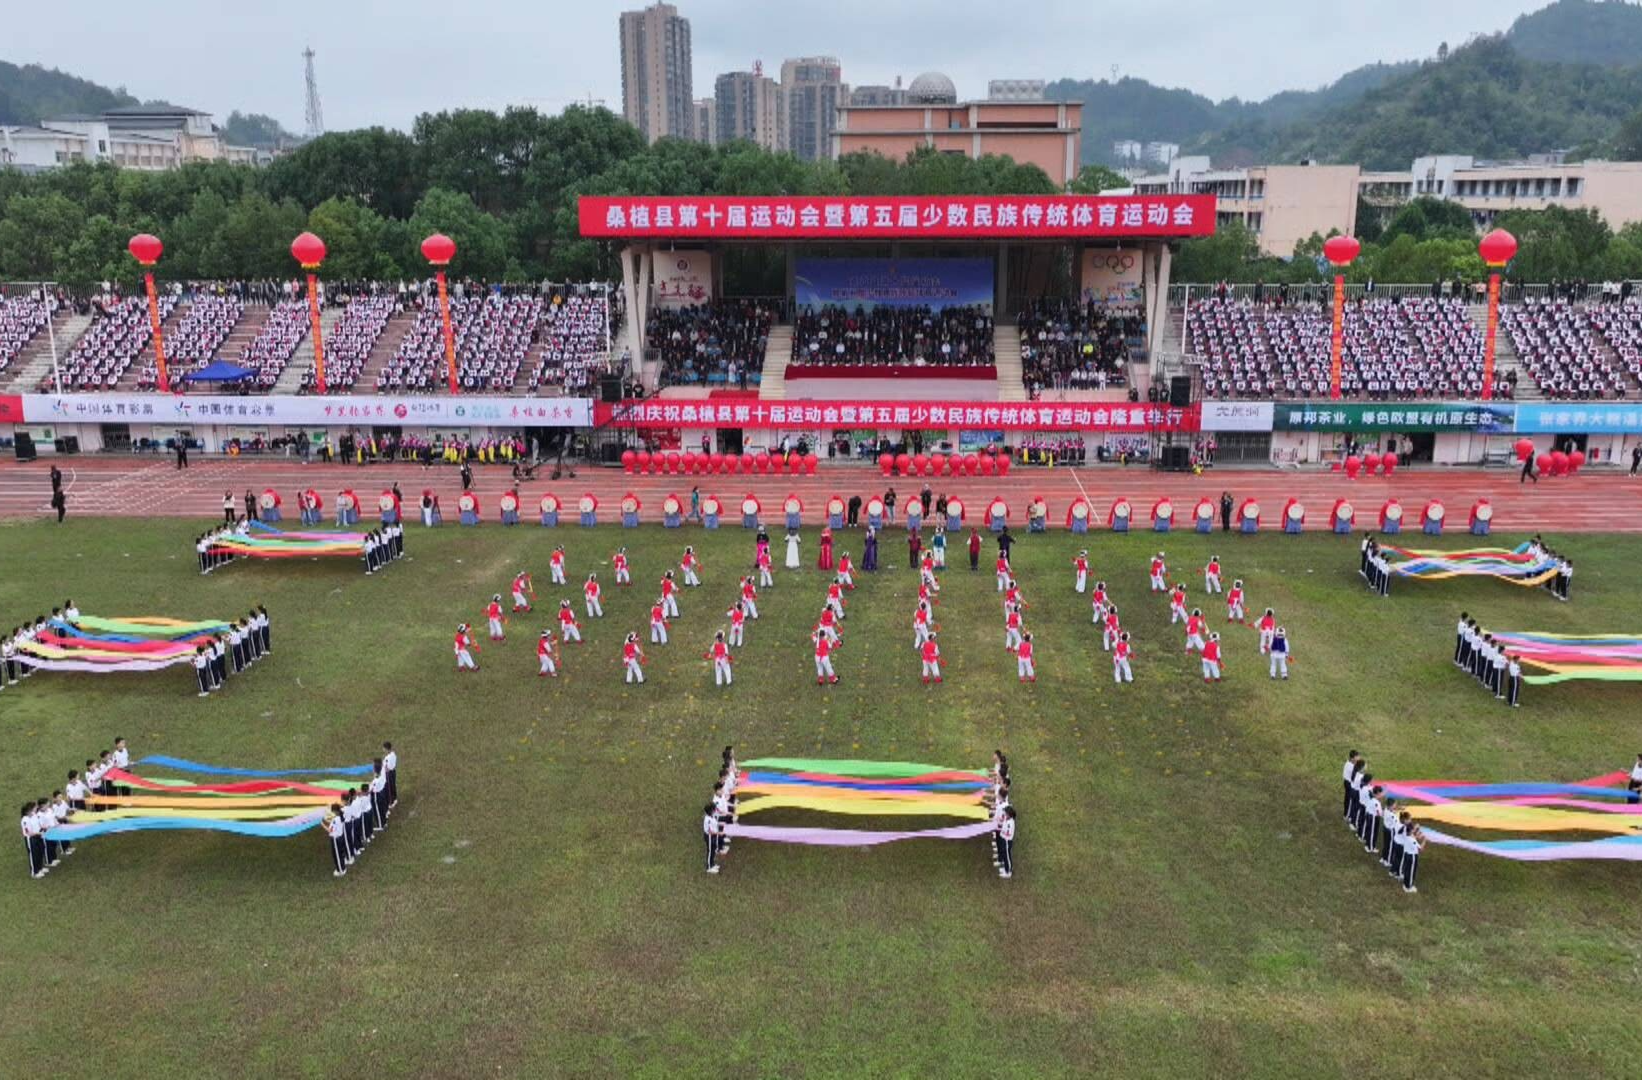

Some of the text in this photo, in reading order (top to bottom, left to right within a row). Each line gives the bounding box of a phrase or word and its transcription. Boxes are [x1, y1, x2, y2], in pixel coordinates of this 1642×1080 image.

[605, 203, 1196, 229] 桑植县第十届运动会暨第五届少数民族传统体育运动会
[611, 403, 1184, 425] 热烈庆祝桑植县第十届运动会暨第五届少数民族传统体育运动会隆重举行
